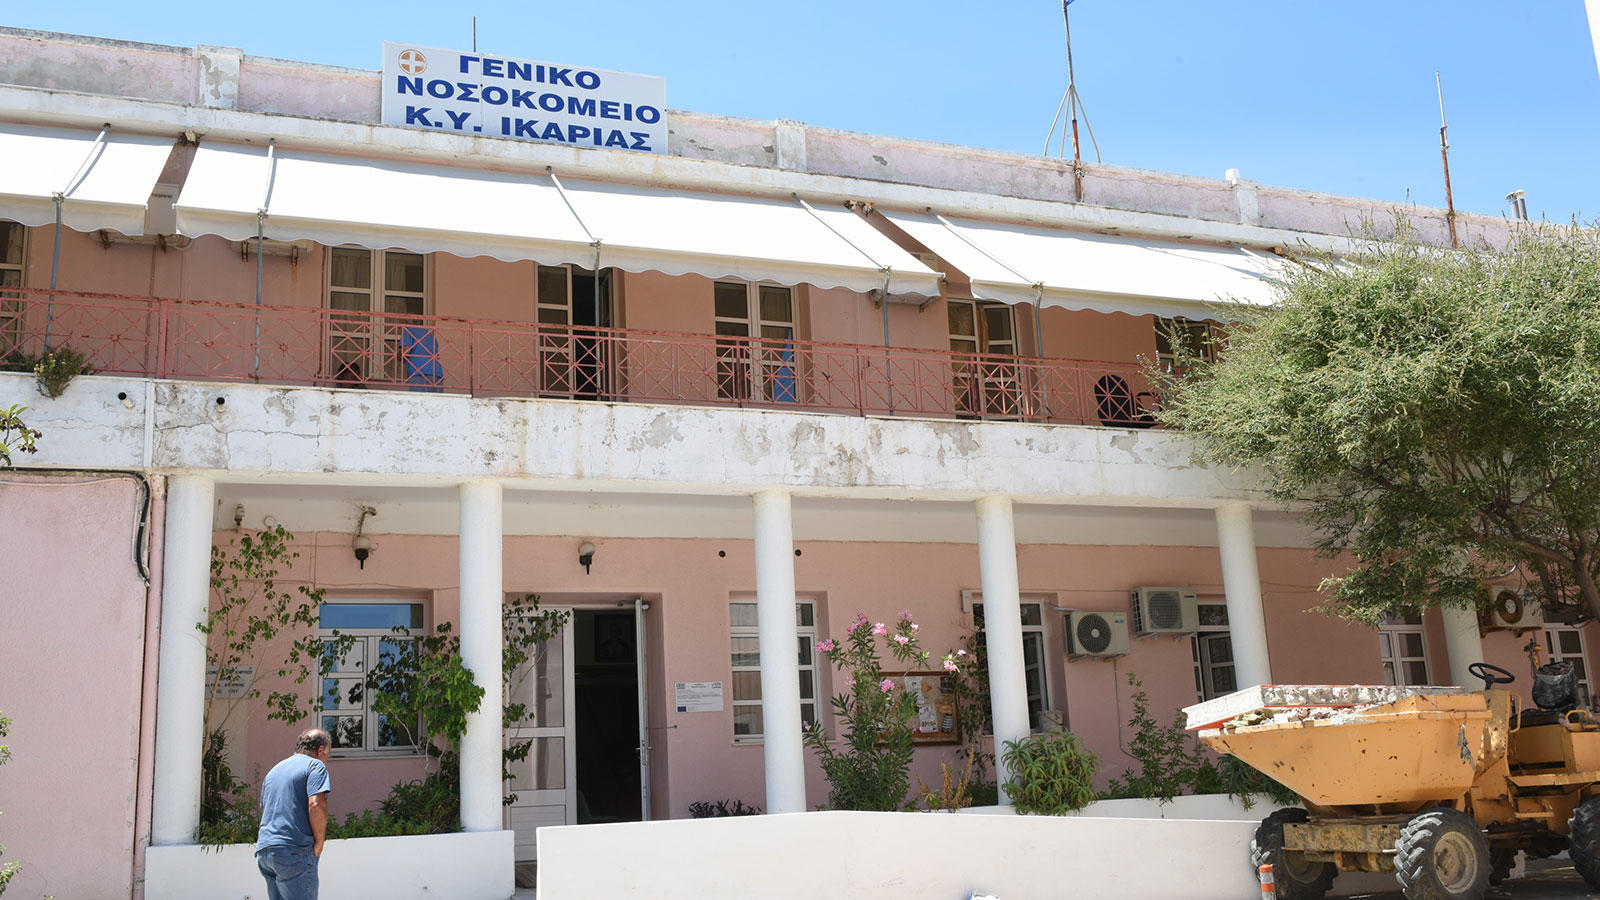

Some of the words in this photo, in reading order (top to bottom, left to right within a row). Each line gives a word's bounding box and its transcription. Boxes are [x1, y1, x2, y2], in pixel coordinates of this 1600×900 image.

[460, 55, 601, 90] ΓΕΝΙΚΟ
[397, 76, 660, 125] ΝΟΣΟΚΟΜΕΙΟ
[406, 105, 483, 133] Κ.Υ.
[502, 117, 652, 152] ΙΚΑΡΙΑΣ
